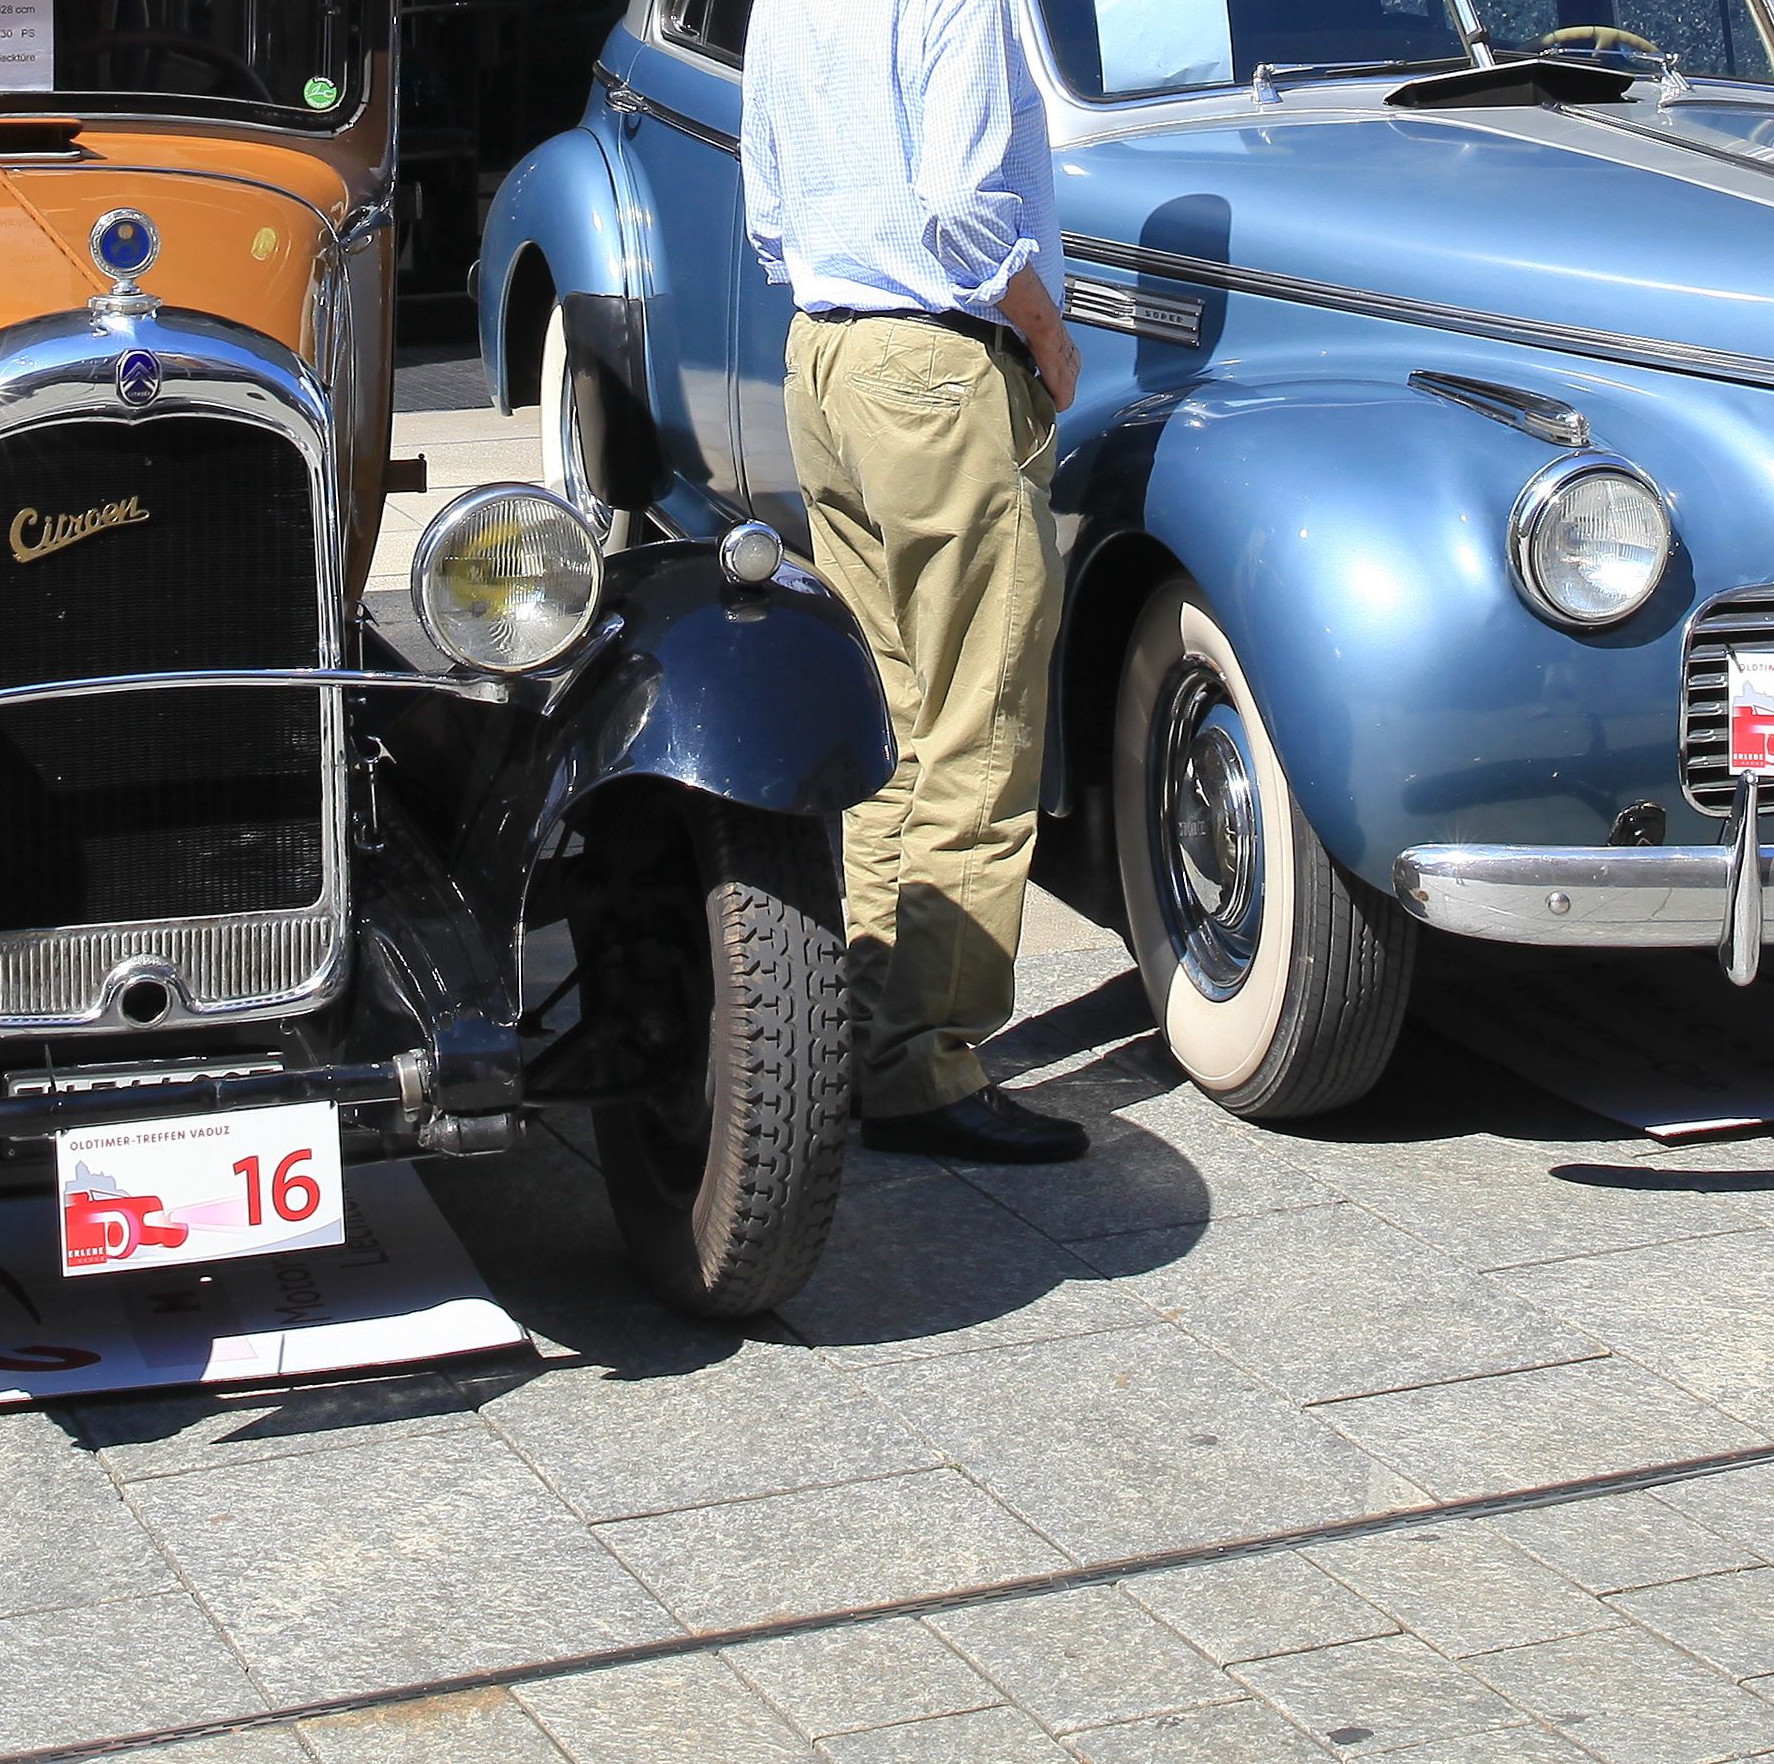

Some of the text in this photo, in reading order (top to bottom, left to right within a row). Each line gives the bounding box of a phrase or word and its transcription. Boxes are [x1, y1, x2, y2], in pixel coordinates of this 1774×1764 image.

[69, 1124, 231, 1152] OLDTIMER-TREFFEN VADUZ
[231, 1147, 322, 1227] 16
